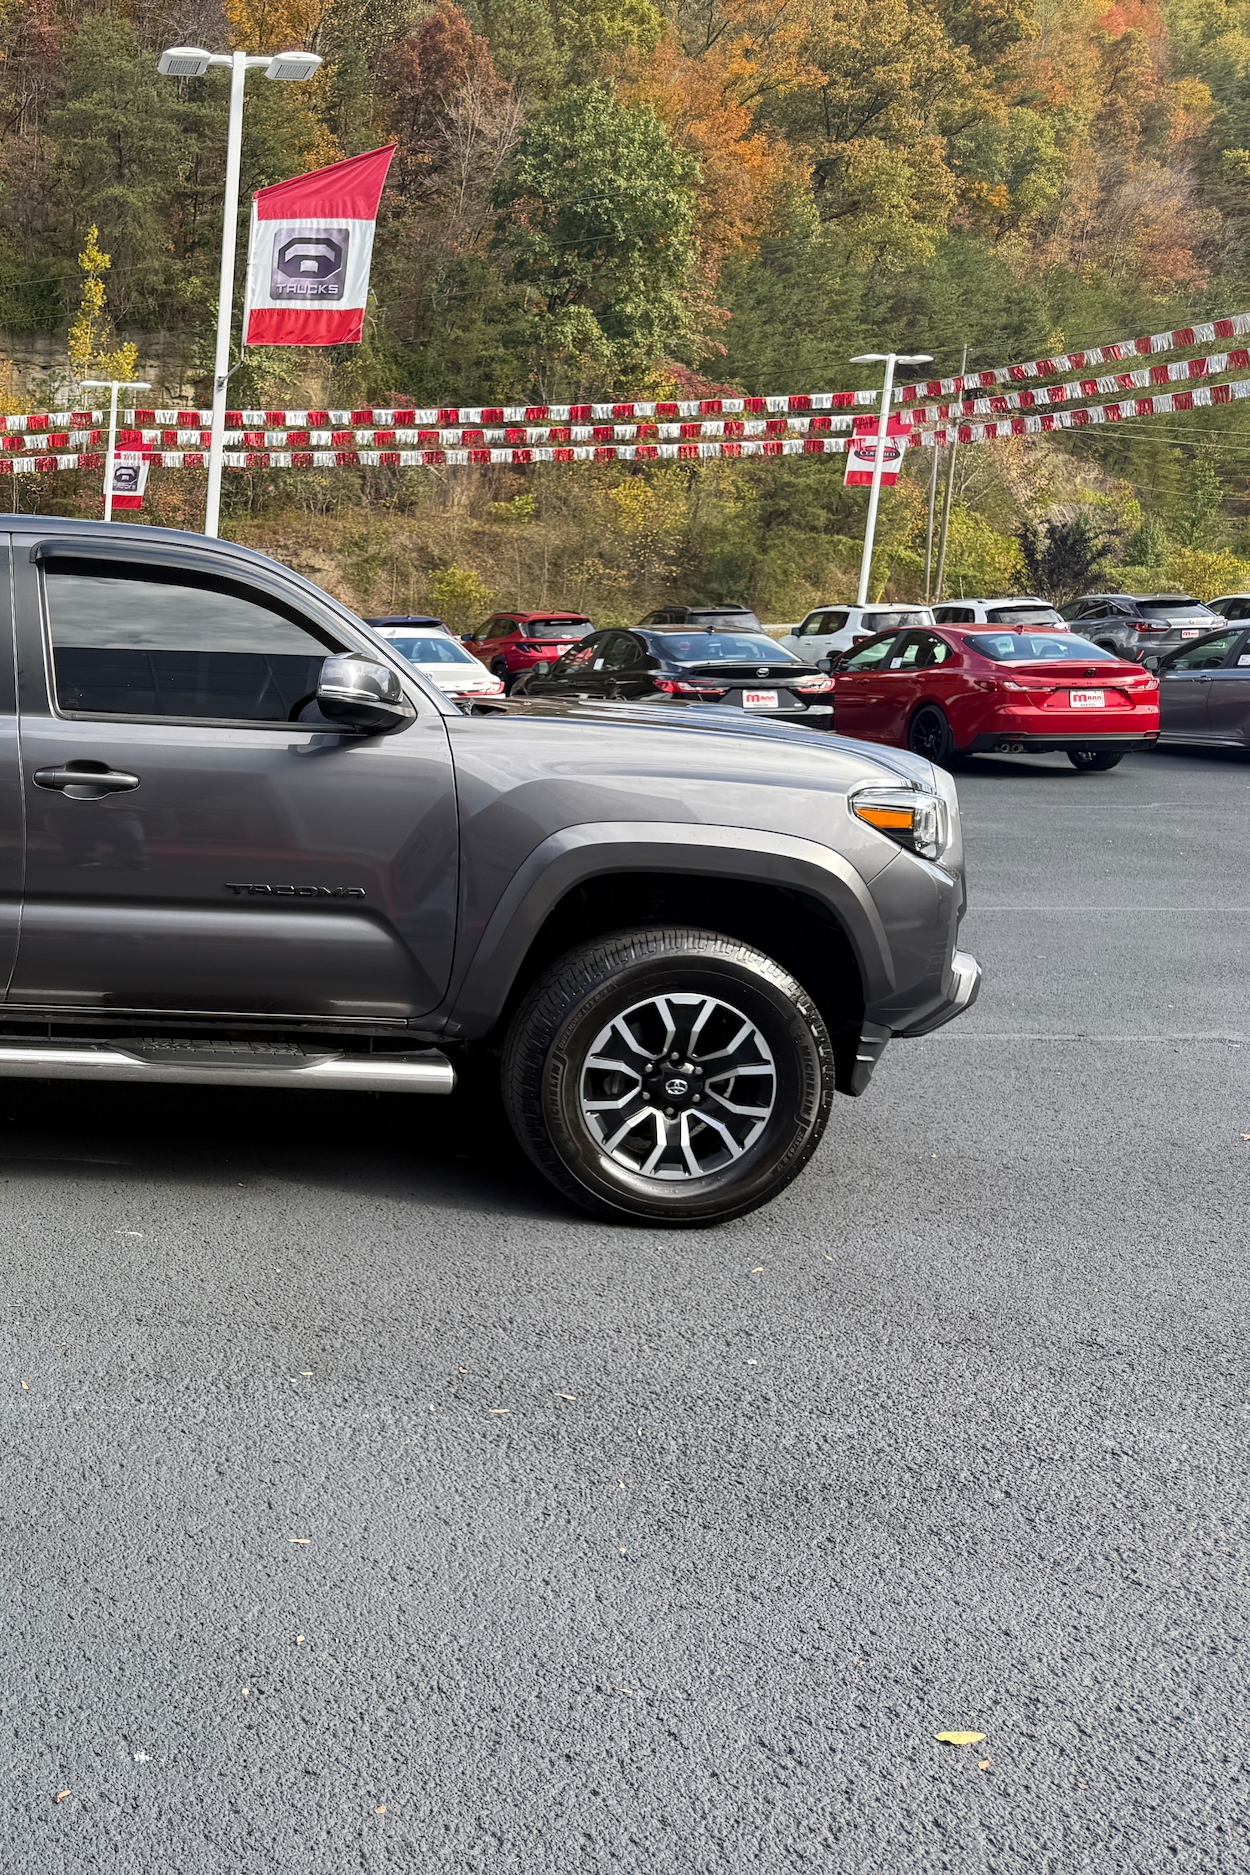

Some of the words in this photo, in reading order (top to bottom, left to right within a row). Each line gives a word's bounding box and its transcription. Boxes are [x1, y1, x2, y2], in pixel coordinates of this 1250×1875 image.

[276, 283, 339, 295] TRUCKS
[225, 882, 367, 899] TACOMA
[800, 1044, 815, 1116] MICHELIN
